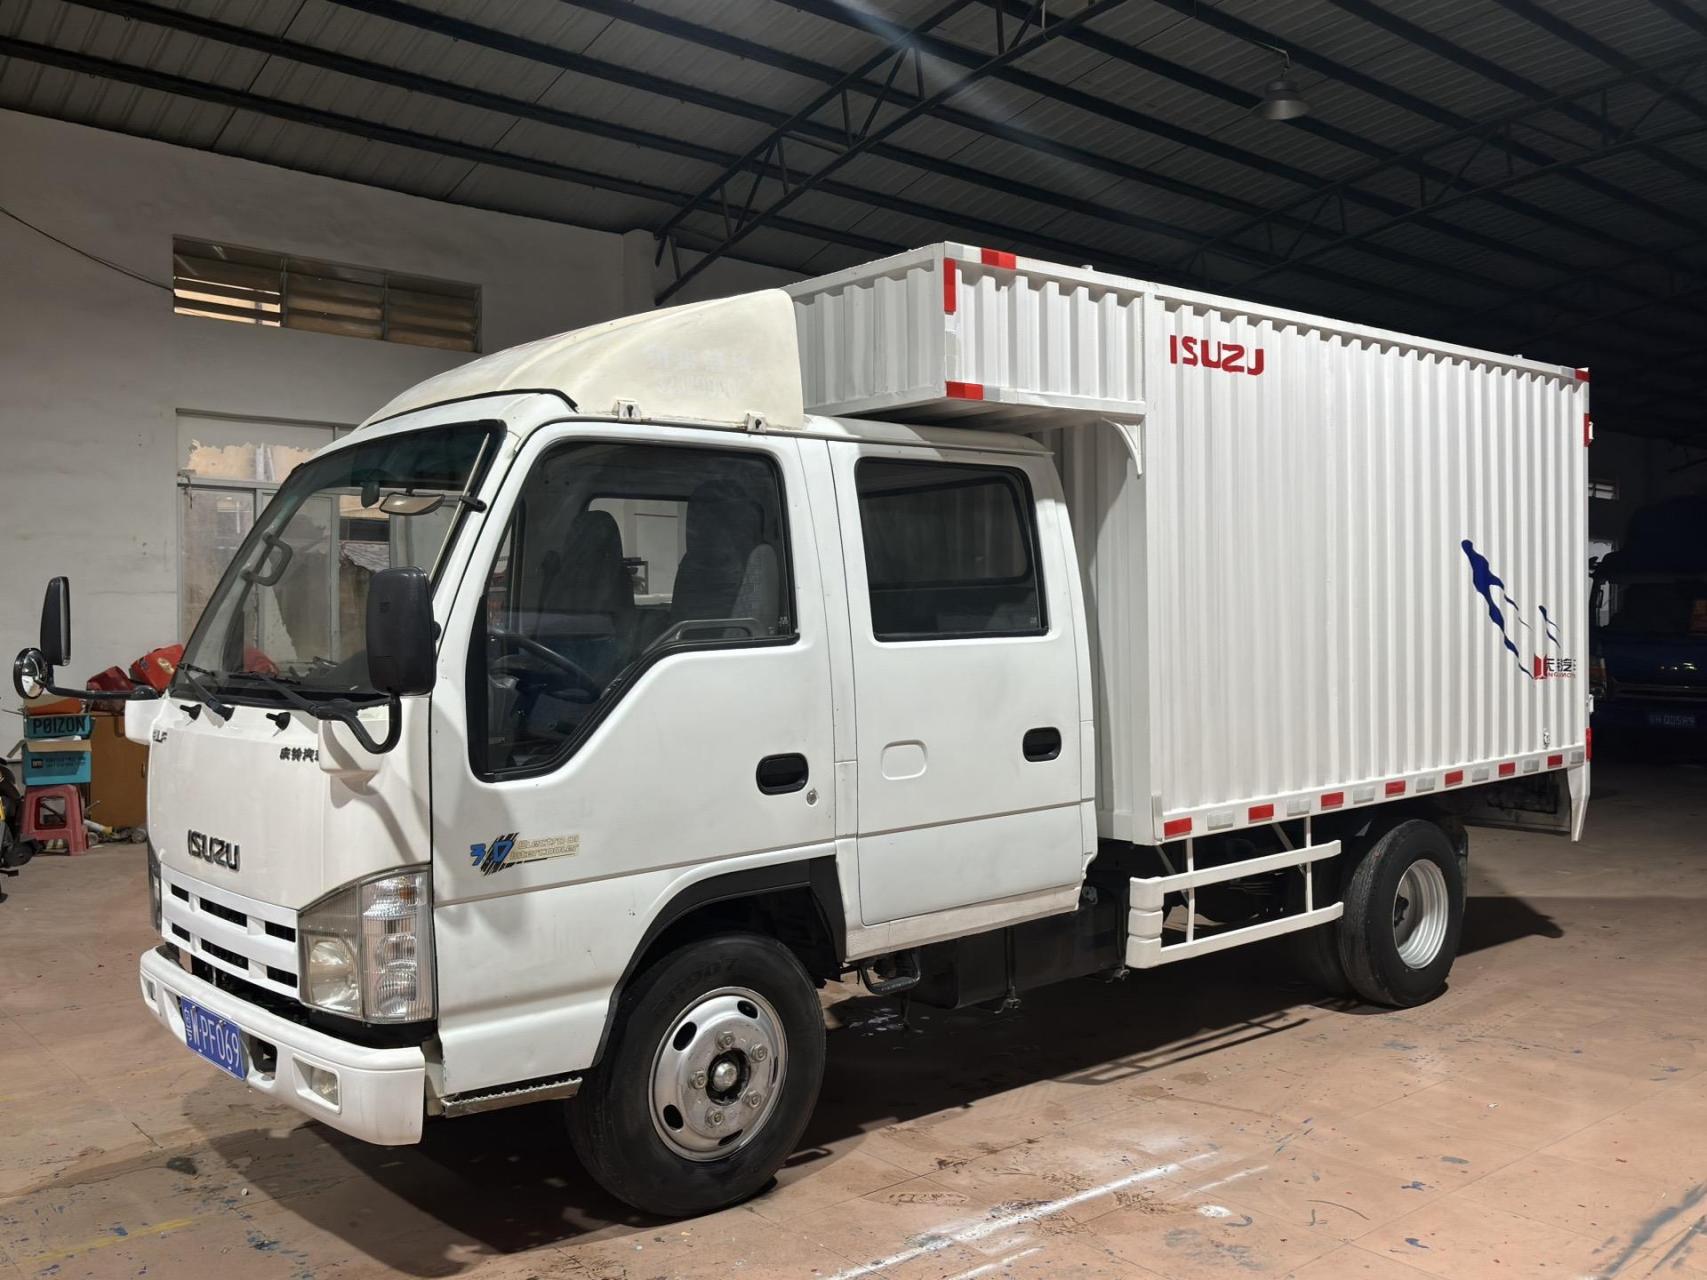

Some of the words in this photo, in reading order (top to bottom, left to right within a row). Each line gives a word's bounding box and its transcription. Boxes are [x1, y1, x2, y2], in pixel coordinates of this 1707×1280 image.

[280, 747, 319, 763] 庆铃汽
[188, 829, 240, 871] ISUZU
